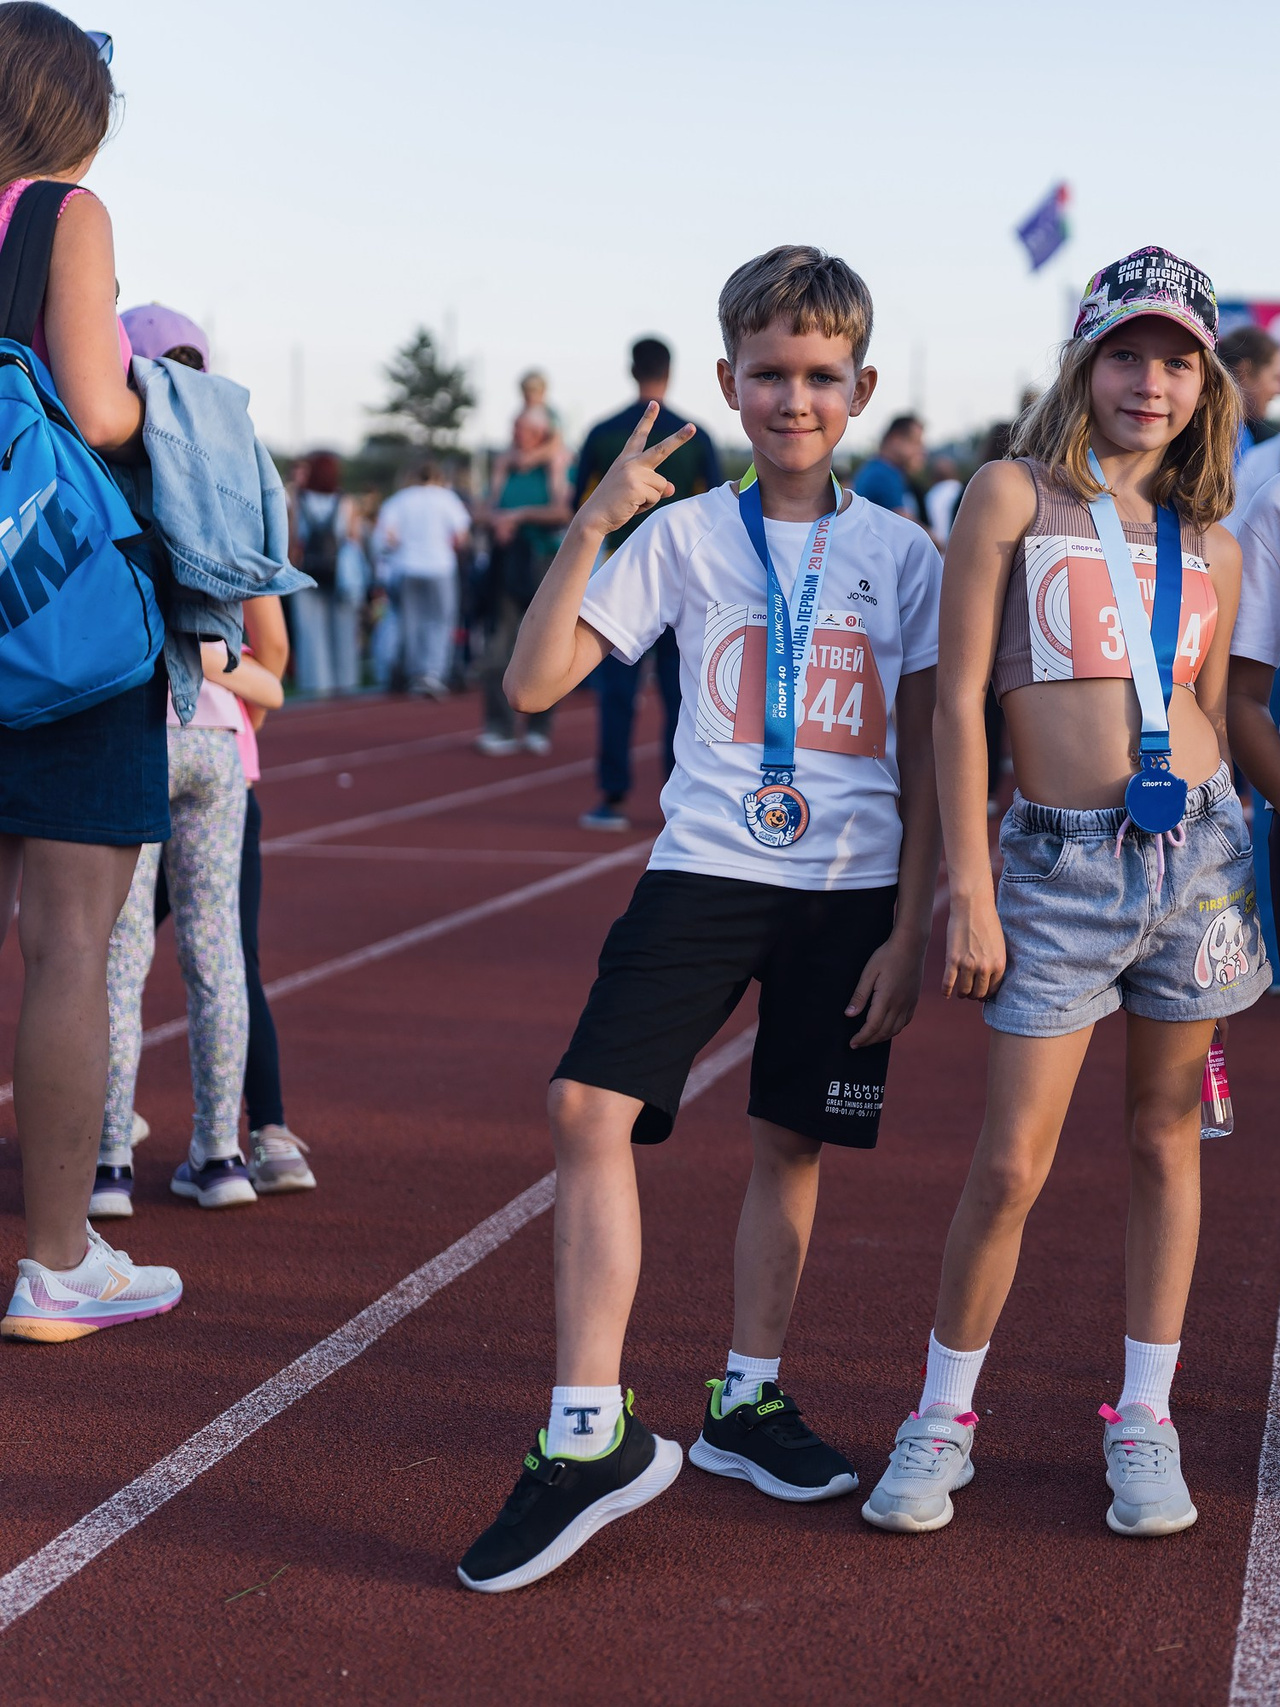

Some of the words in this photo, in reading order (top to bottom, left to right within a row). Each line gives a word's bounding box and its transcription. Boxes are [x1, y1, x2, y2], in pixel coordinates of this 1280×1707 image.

[1164, 258, 1196, 278] WAIT
[1197, 273, 1210, 288] FO
[1117, 268, 1143, 285] THE
[1145, 267, 1188, 285] RIGHT
[1189, 279, 1212, 298] TIM
[1071, 544, 1093, 552] СПОРТ
[0, 478, 94, 640] IKE
[808, 556, 823, 571] 29
[796, 574, 819, 623] ПЕРВЫМ
[846, 592, 878, 606] JOMOTO
[773, 593, 785, 655] КАЛУЖСКИЙ
[791, 626, 810, 660] СТАНЬ
[808, 644, 865, 673] АТВЕЙ
[778, 666, 787, 679] 40
[778, 680, 787, 718] СПОРТ
[1199, 895, 1228, 912] FIRST
[843, 1090, 879, 1100] MOOD
[844, 1082, 885, 1093] SUMME
[826, 1098, 843, 1107] GREAT
[844, 1100, 863, 1109] THINGS
[756, 1399, 785, 1416] GSD
[563, 1406, 601, 1435] T
[927, 1424, 951, 1435] GSD
[1122, 1426, 1146, 1434] GSD
